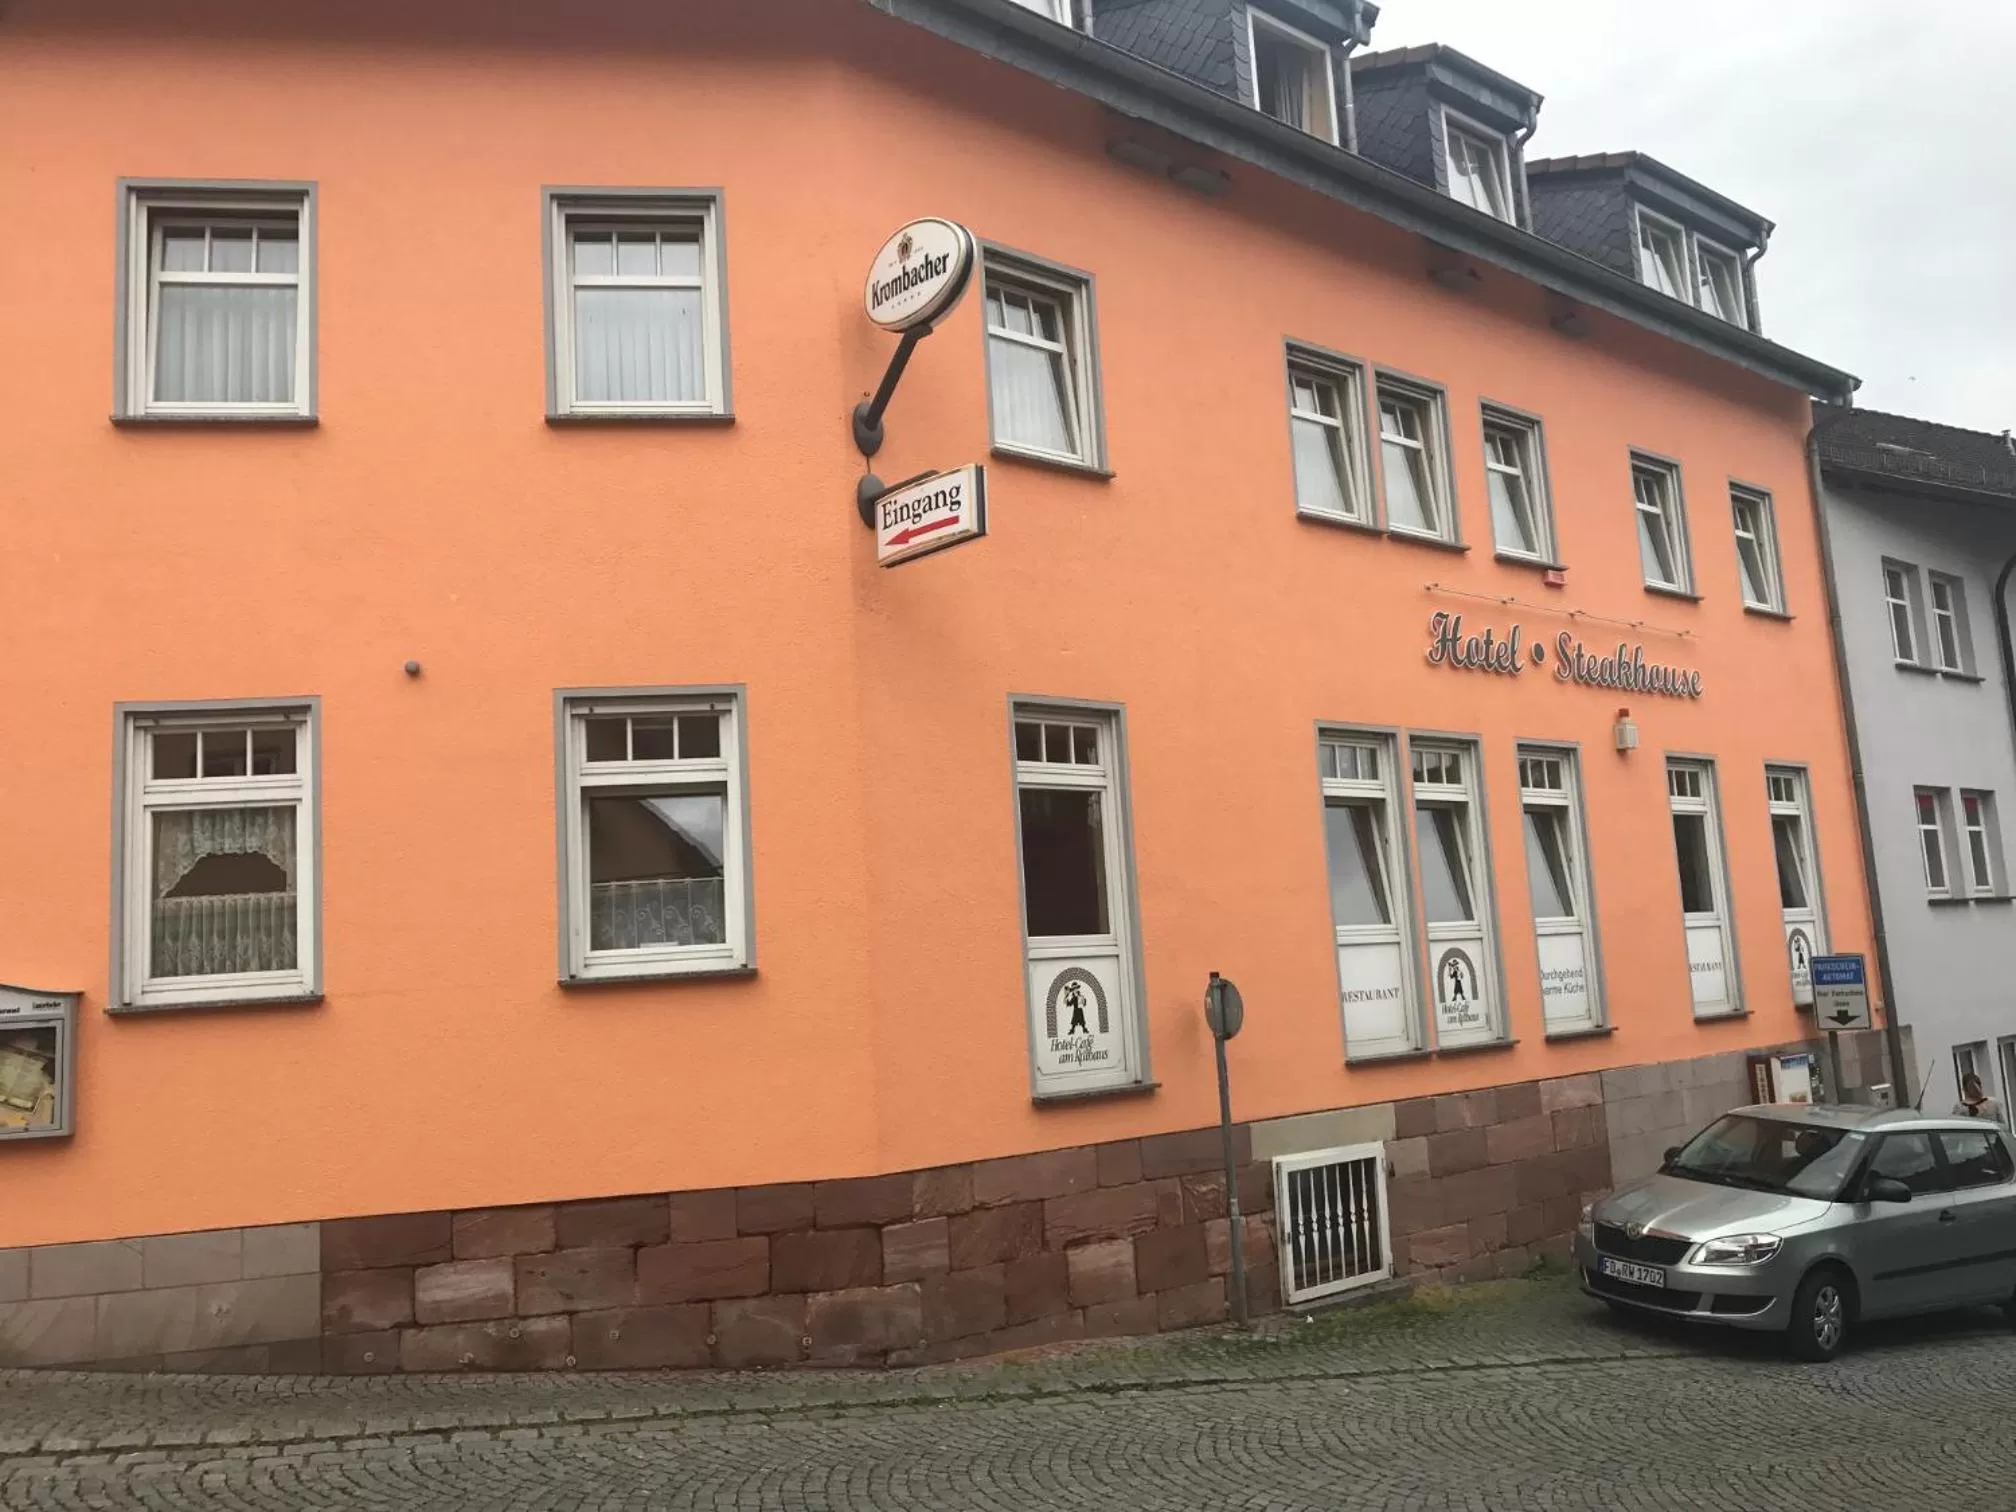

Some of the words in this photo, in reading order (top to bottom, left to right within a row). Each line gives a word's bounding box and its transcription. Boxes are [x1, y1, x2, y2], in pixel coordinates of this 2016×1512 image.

[872, 252, 950, 310] Krombacher
[881, 483, 962, 532] Eingang
[1428, 611, 1524, 676] Hotel
[1555, 632, 1704, 698] Steakhouse
[1058, 1052, 1074, 1065] am
[1637, 1266, 1663, 1286] 1702
